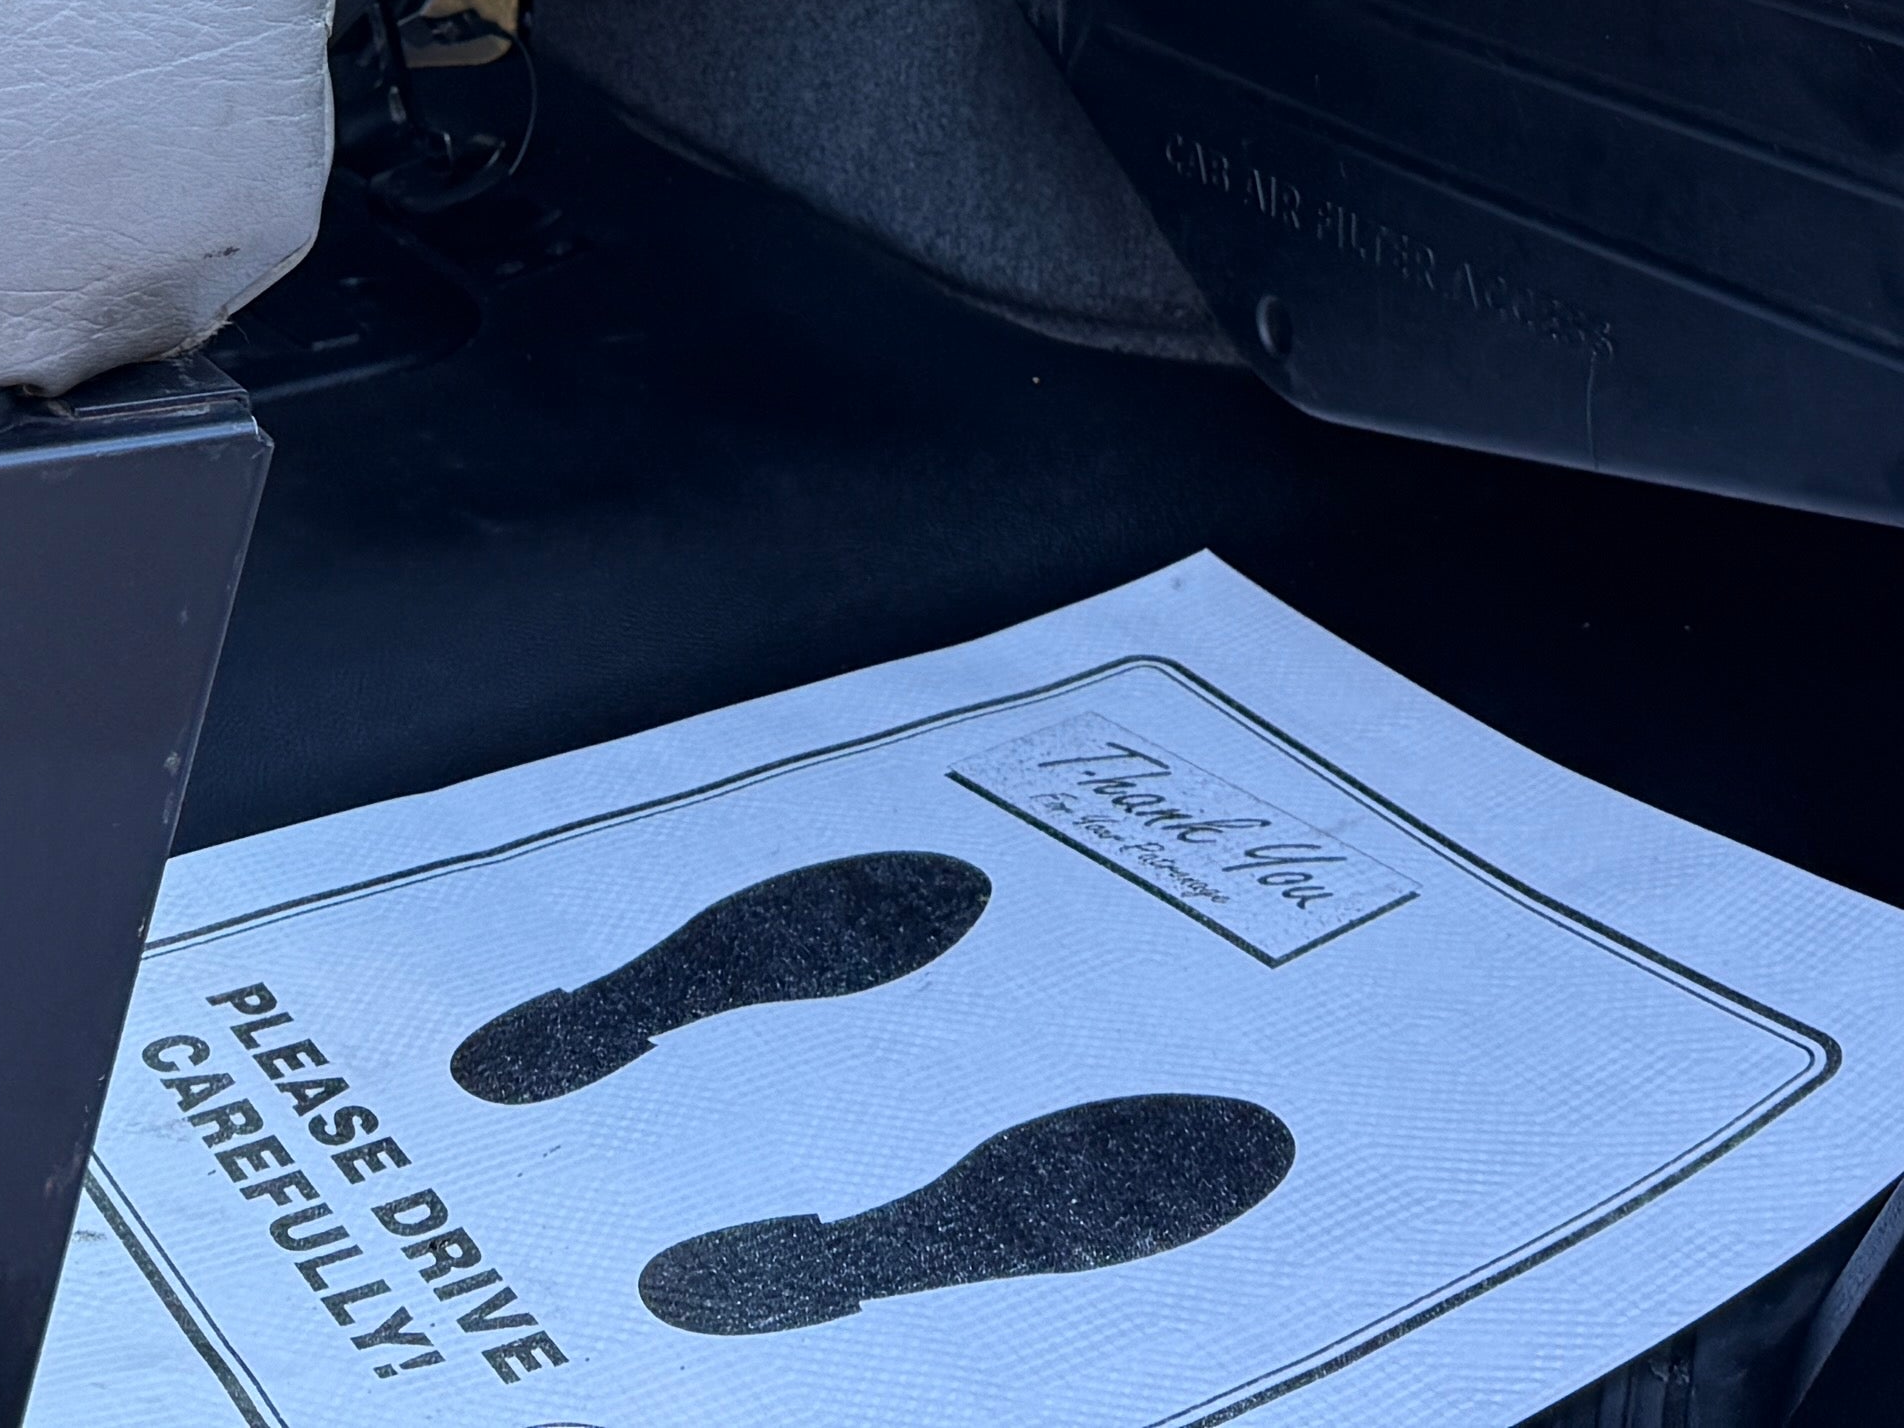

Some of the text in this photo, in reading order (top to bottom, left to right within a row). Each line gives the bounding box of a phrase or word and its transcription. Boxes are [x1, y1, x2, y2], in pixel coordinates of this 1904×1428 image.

[1164, 132, 1231, 193] CAB
[1243, 167, 1302, 231] AIR
[1316, 199, 1438, 292] FILTER
[1029, 791, 1231, 905] For Your Patronage
[1037, 741, 1348, 910] Thank You
[141, 1034, 448, 1380] CAREFULLY!
[205, 981, 570, 1386] PLEASE DRIVE
